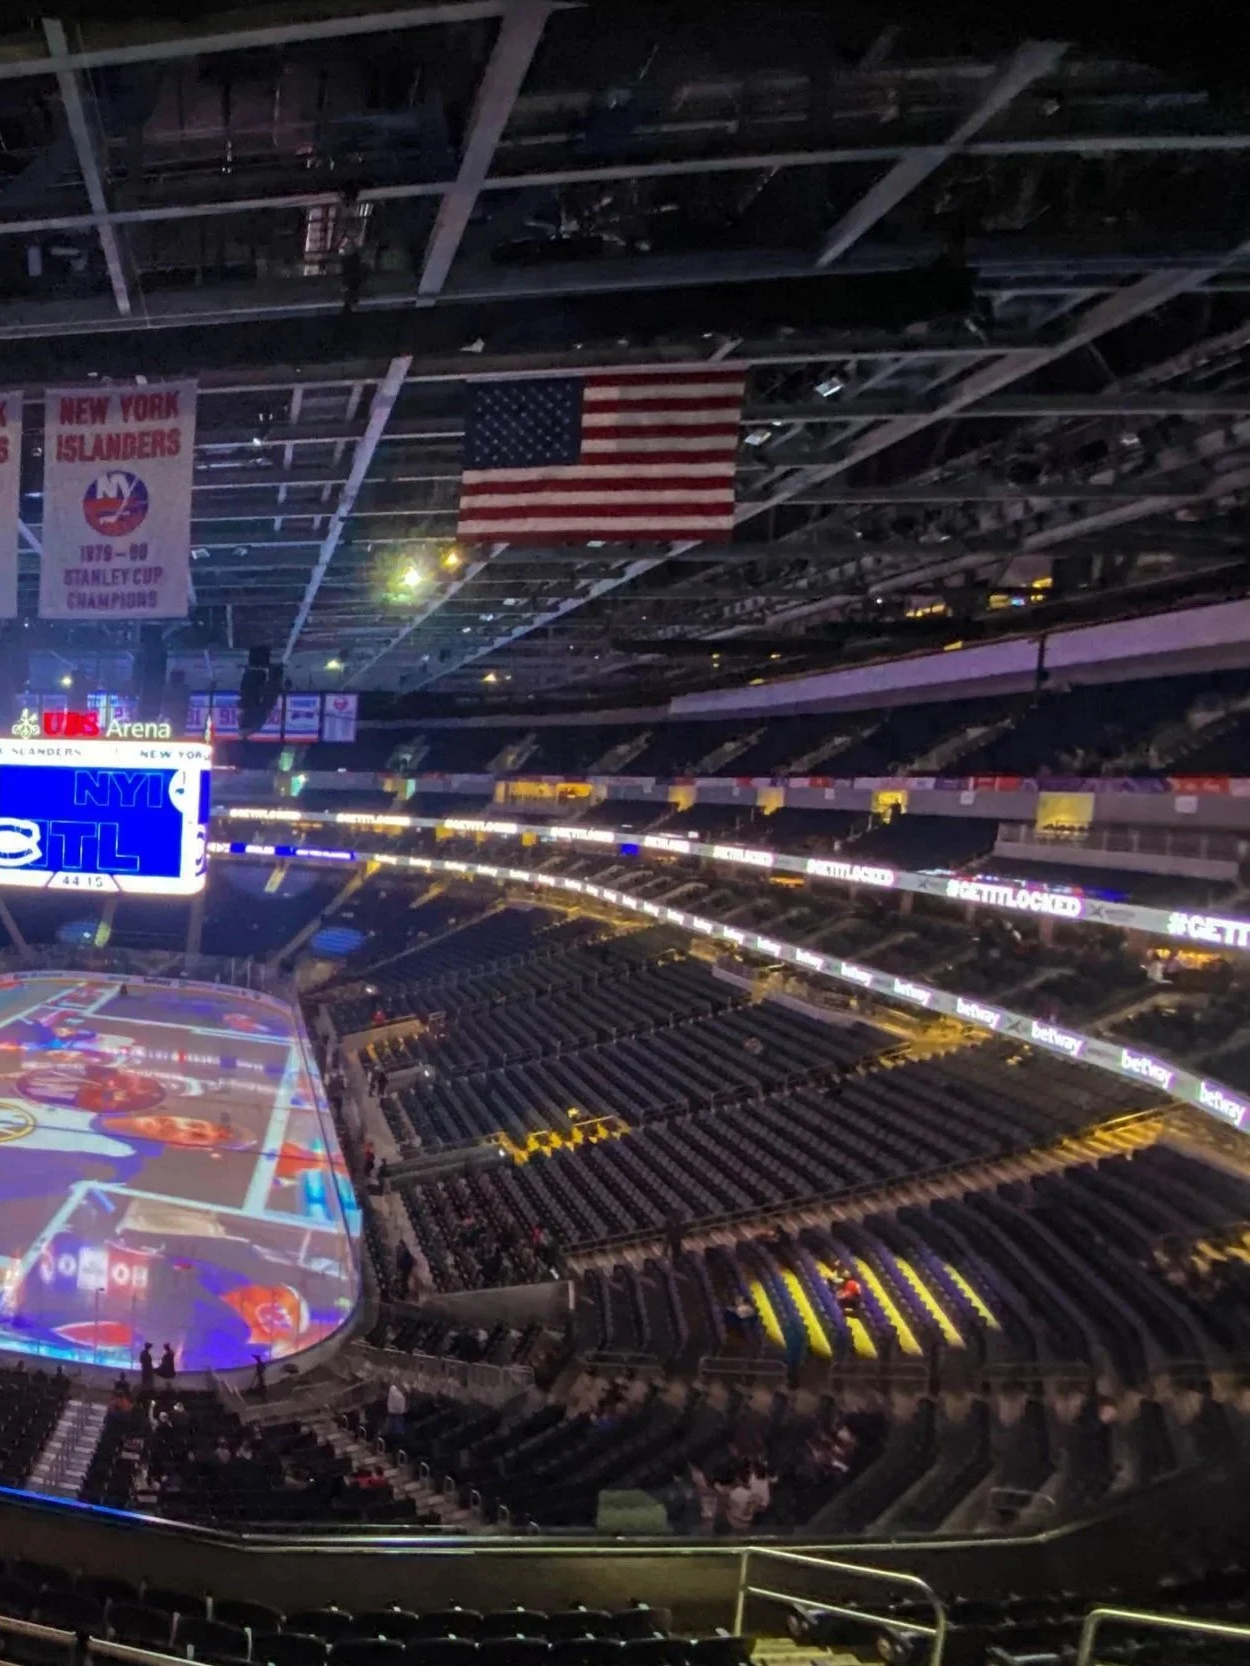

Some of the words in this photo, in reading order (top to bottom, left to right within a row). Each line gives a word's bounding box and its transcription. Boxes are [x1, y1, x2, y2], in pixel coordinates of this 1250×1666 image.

[59, 396, 110, 425] NEW
[120, 390, 180, 423] YORK
[56, 427, 181, 463] ISLANDERS
[63, 567, 130, 586] STANLEY
[133, 566, 163, 584] CUP
[66, 590, 157, 610] CHAMPIONS
[105, 719, 172, 739] Arena
[73, 769, 165, 809] NYI
[945, 878, 1083, 918] #GETITLOCKED
[893, 977, 932, 1007] betway
[956, 997, 1001, 1030] betway
[1030, 1020, 1083, 1057] betway
[1120, 1048, 1173, 1090] betway
[1198, 1081, 1247, 1127] betway
